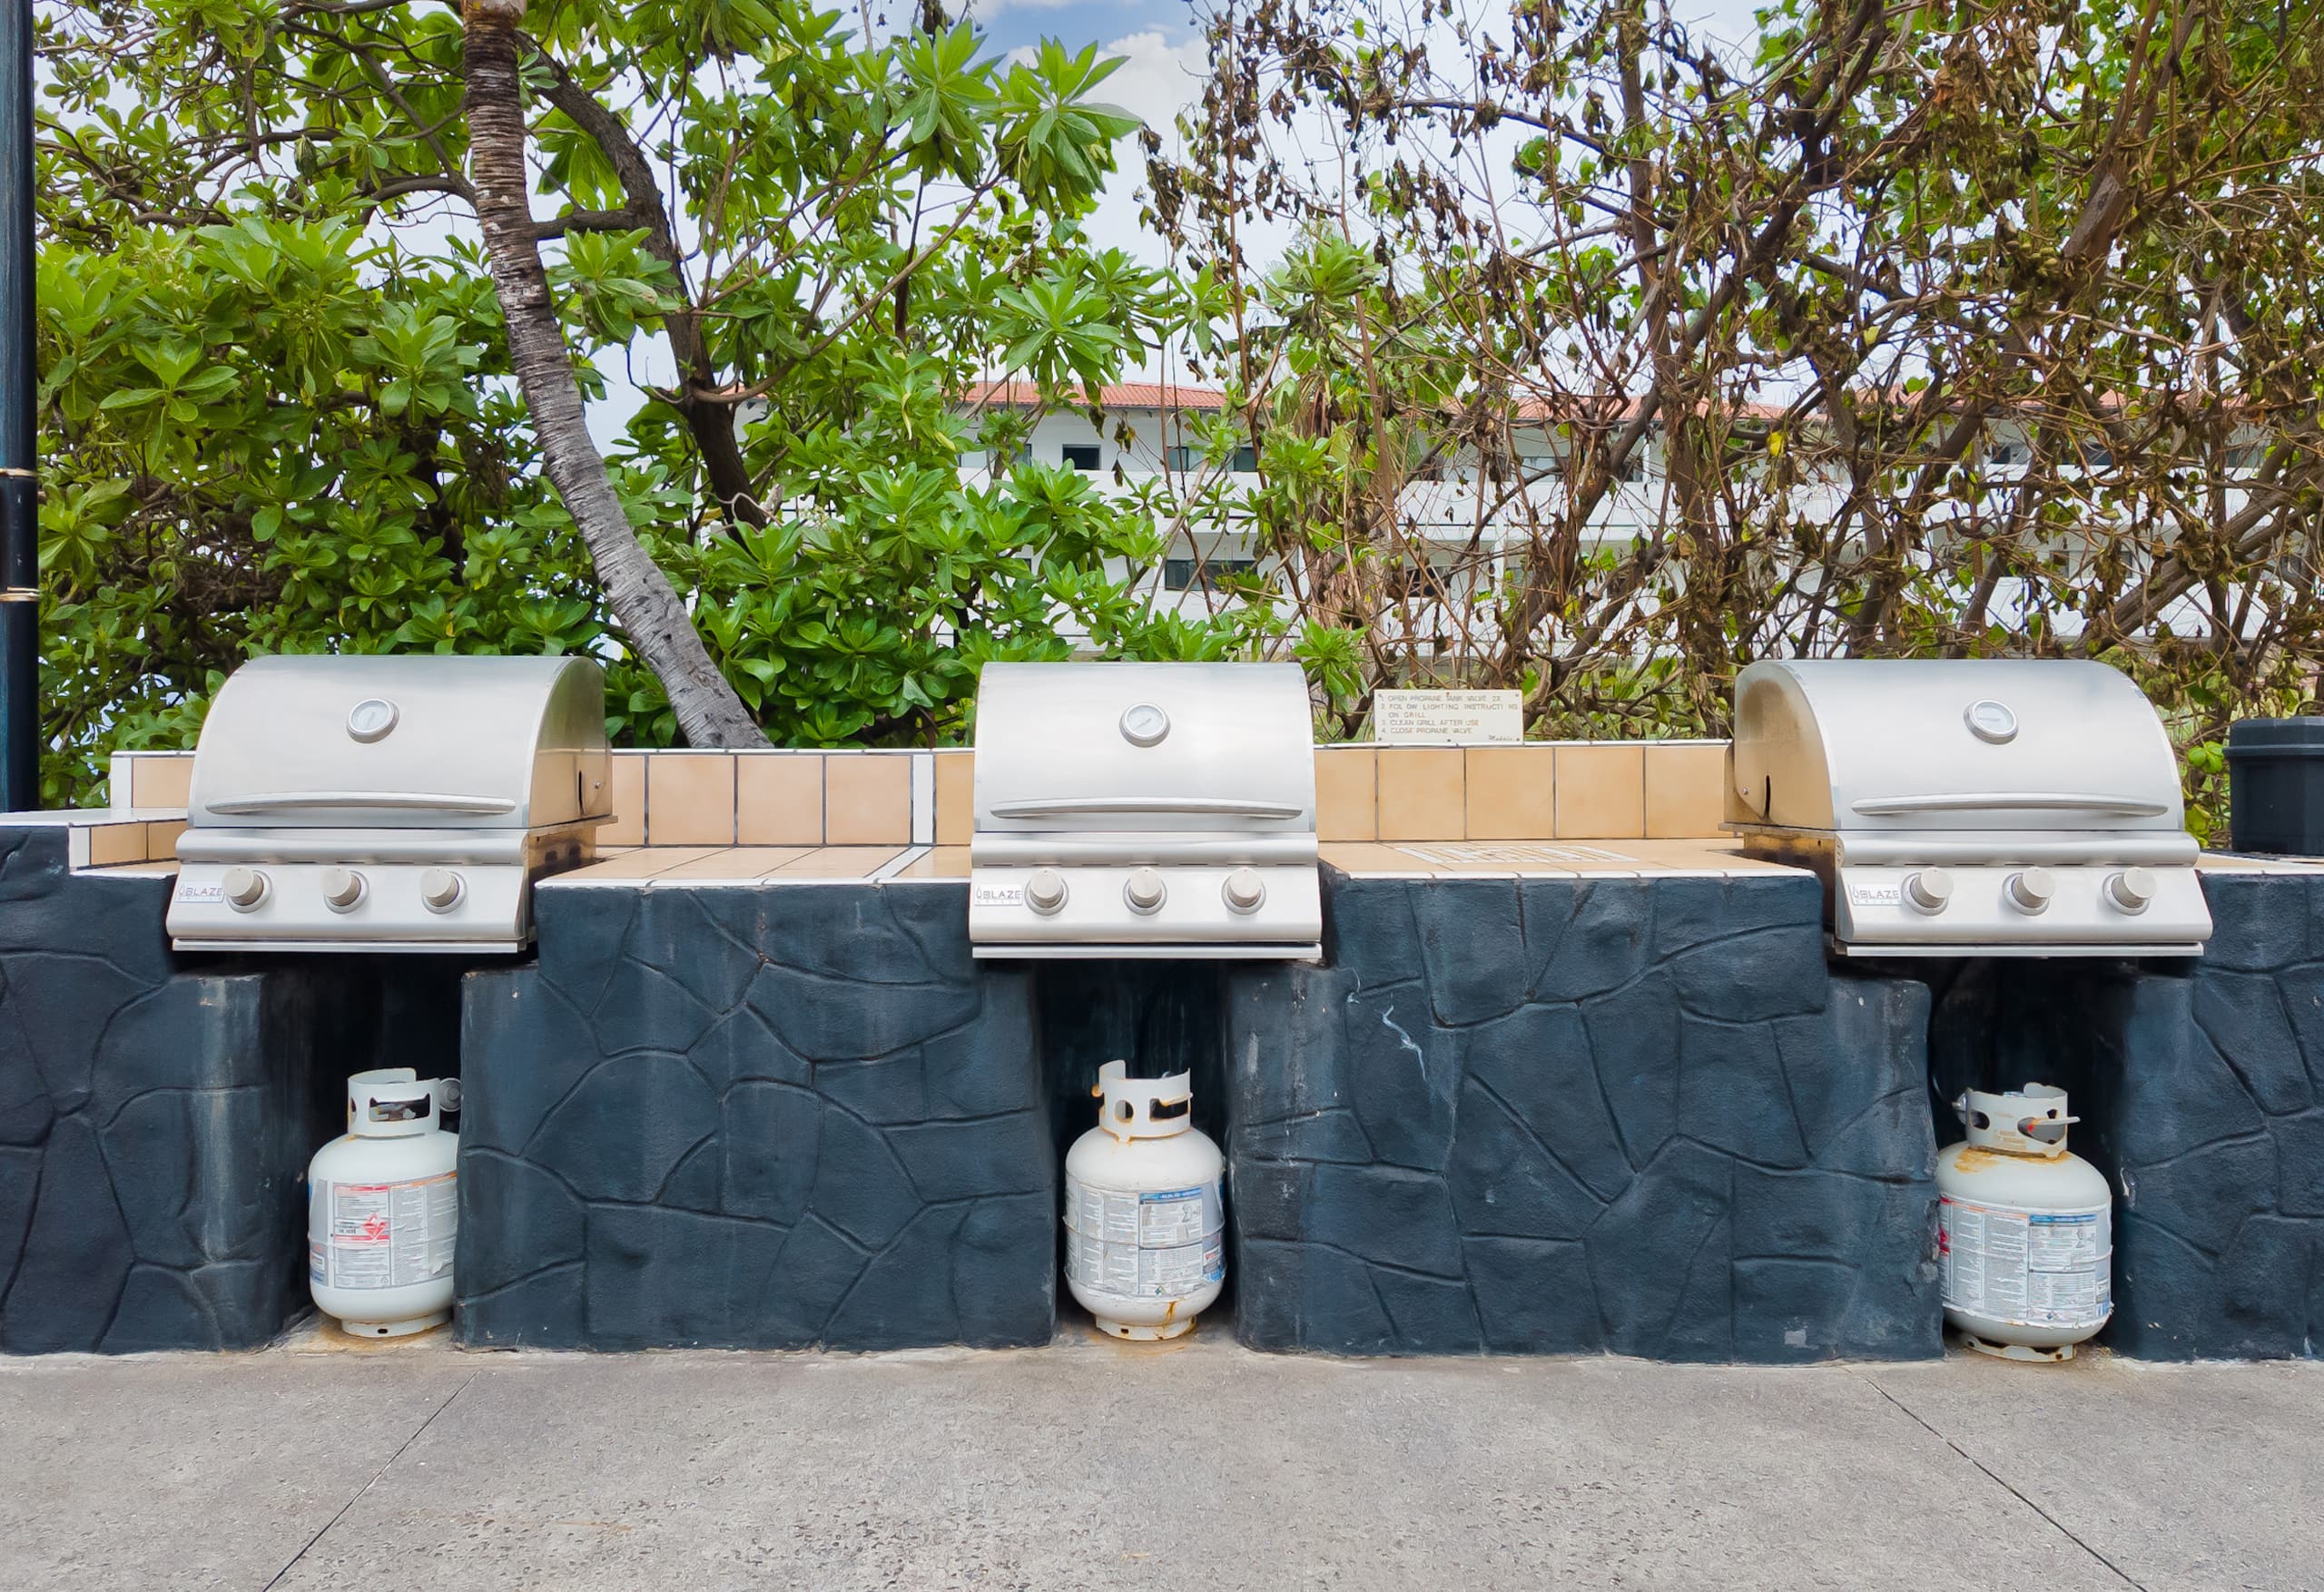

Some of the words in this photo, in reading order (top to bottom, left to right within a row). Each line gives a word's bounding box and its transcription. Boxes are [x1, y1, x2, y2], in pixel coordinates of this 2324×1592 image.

[1423, 703, 1459, 711] LIGHTING
[186, 887, 222, 896] BLAZE
[983, 890, 1021, 899] BLAZE
[1859, 890, 1899, 899] BLAZE
